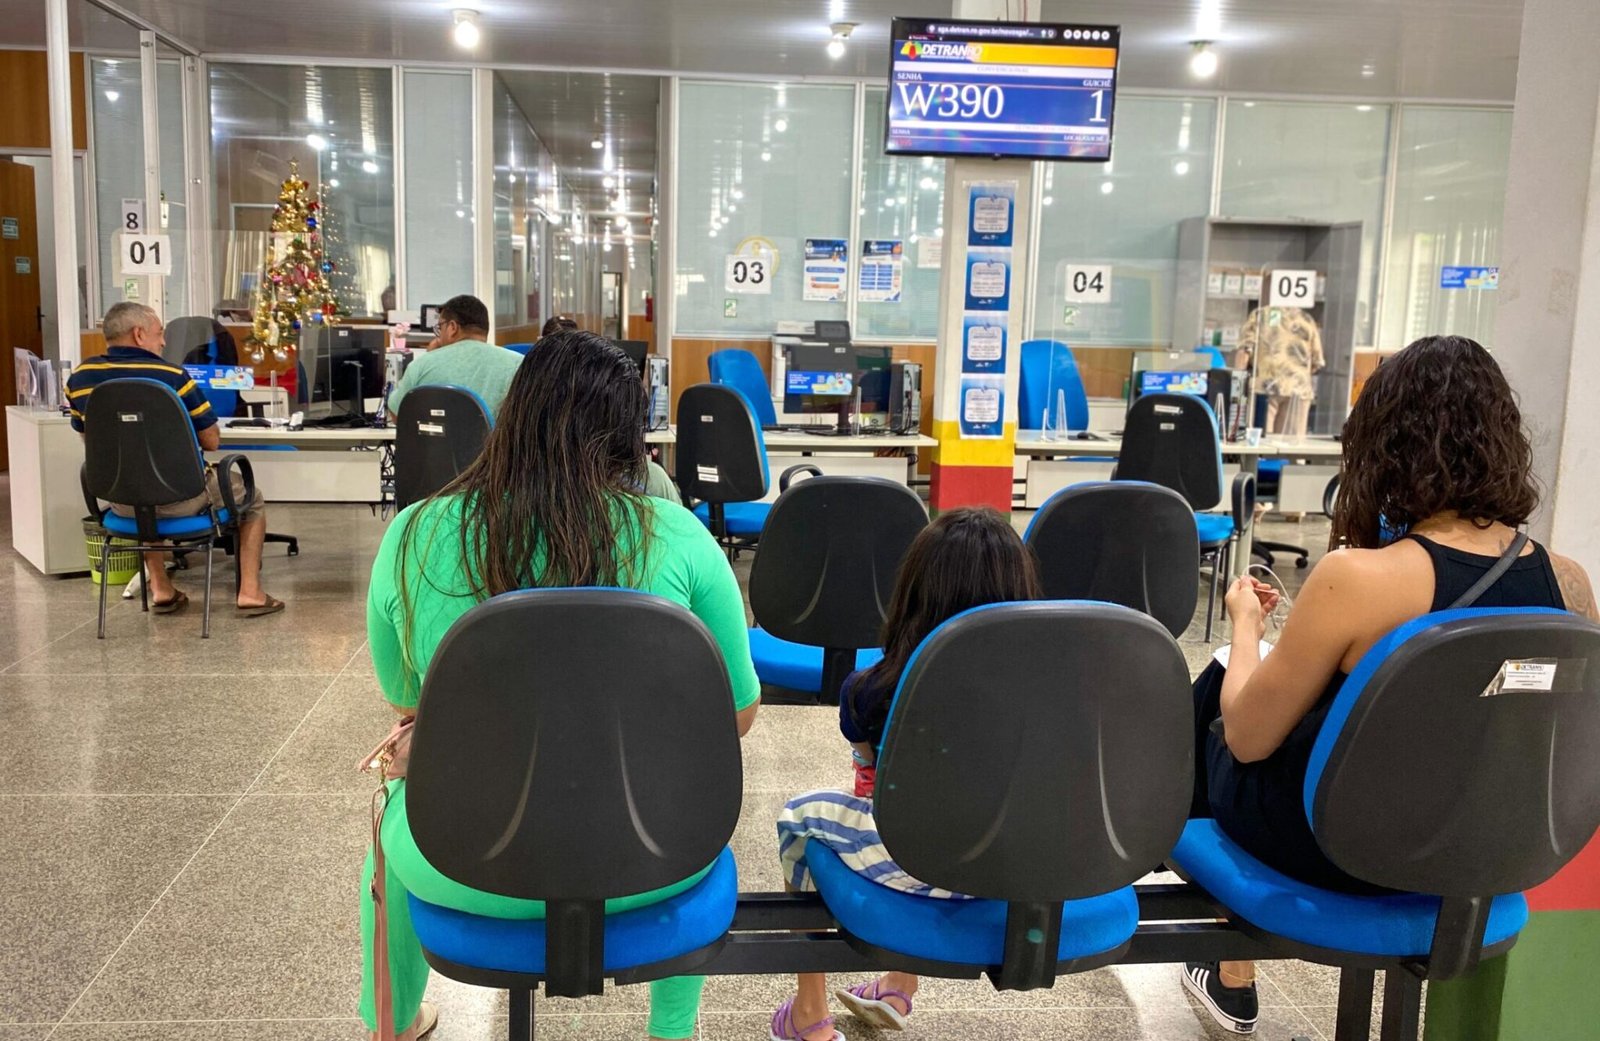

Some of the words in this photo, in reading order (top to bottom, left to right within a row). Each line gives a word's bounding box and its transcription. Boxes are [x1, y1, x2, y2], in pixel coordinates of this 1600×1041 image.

[897, 72, 922, 80] SENHA
[1083, 78, 1112, 87] GUICHÊ
[897, 82, 1004, 119] W390
[1089, 89, 1107, 122] 1
[130, 240, 160, 265] 01
[733, 260, 764, 284] 03
[1073, 271, 1104, 293] 04
[1278, 276, 1308, 298] 05
